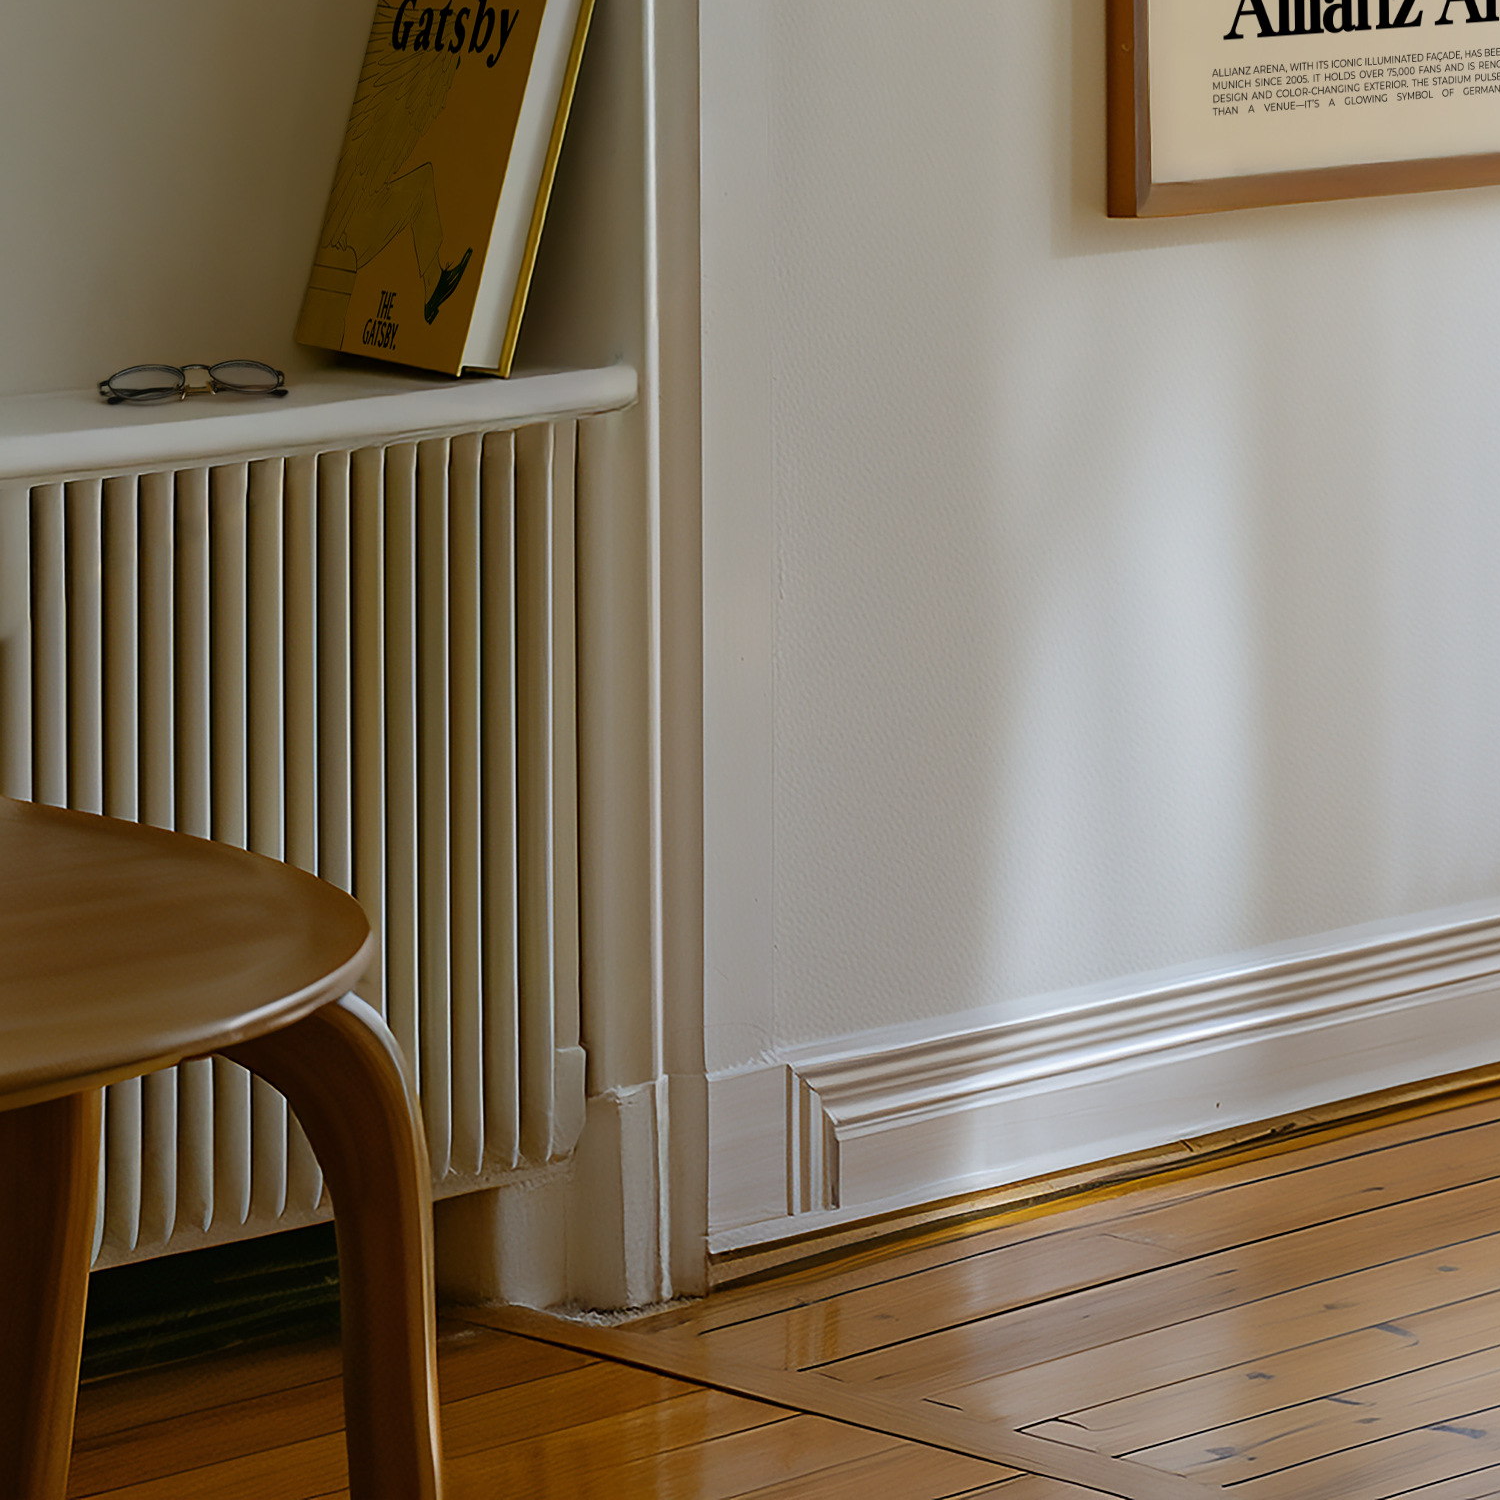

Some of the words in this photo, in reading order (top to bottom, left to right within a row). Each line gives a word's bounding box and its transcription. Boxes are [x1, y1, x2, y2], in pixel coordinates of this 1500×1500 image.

[1211, 65, 1252, 78] ALLIANZ
[1252, 63, 1288, 75] ARENA,
[1289, 61, 1314, 72] WITH
[1315, 60, 1330, 70] ITS
[1331, 57, 1363, 69] ICONIC
[1364, 53, 1425, 67] ILLUMINATED
[1426, 50, 1463, 63] FAÇADE,
[1464, 48, 1483, 59] HAS
[1212, 78, 1252, 91] MUNICH
[1254, 76, 1283, 88] SINCE
[1285, 74, 1310, 85] 2005.
[1312, 73, 1322, 83] IT
[1324, 70, 1356, 82] HOLDS
[1358, 68, 1385, 80] OVER
[1386, 66, 1416, 78] 75,000
[1418, 63, 1442, 75] FANS
[1444, 62, 1465, 73] AND
[1467, 61, 1476, 71] IS
[1211, 105, 1239, 117] THAN
[1247, 104, 1256, 114] A
[1328, 97, 1336, 107] A
[1344, 93, 1388, 106] GLOWING
[1396, 89, 1434, 102] SYMBOL
[1441, 87, 1455, 98] OF
[1462, 84, 1500, 96] GERMAN
[1212, 91, 1248, 104] DESIGN
[1251, 89, 1273, 101] AND
[1275, 82, 1361, 99] COLOR-CHANGING
[1363, 79, 1409, 92] EXTERIOR.
[1411, 77, 1430, 88] THE
[1432, 74, 1472, 87] STADIUM
[376, 290, 397, 321] THE
[362, 318, 400, 351] GATSBY.
